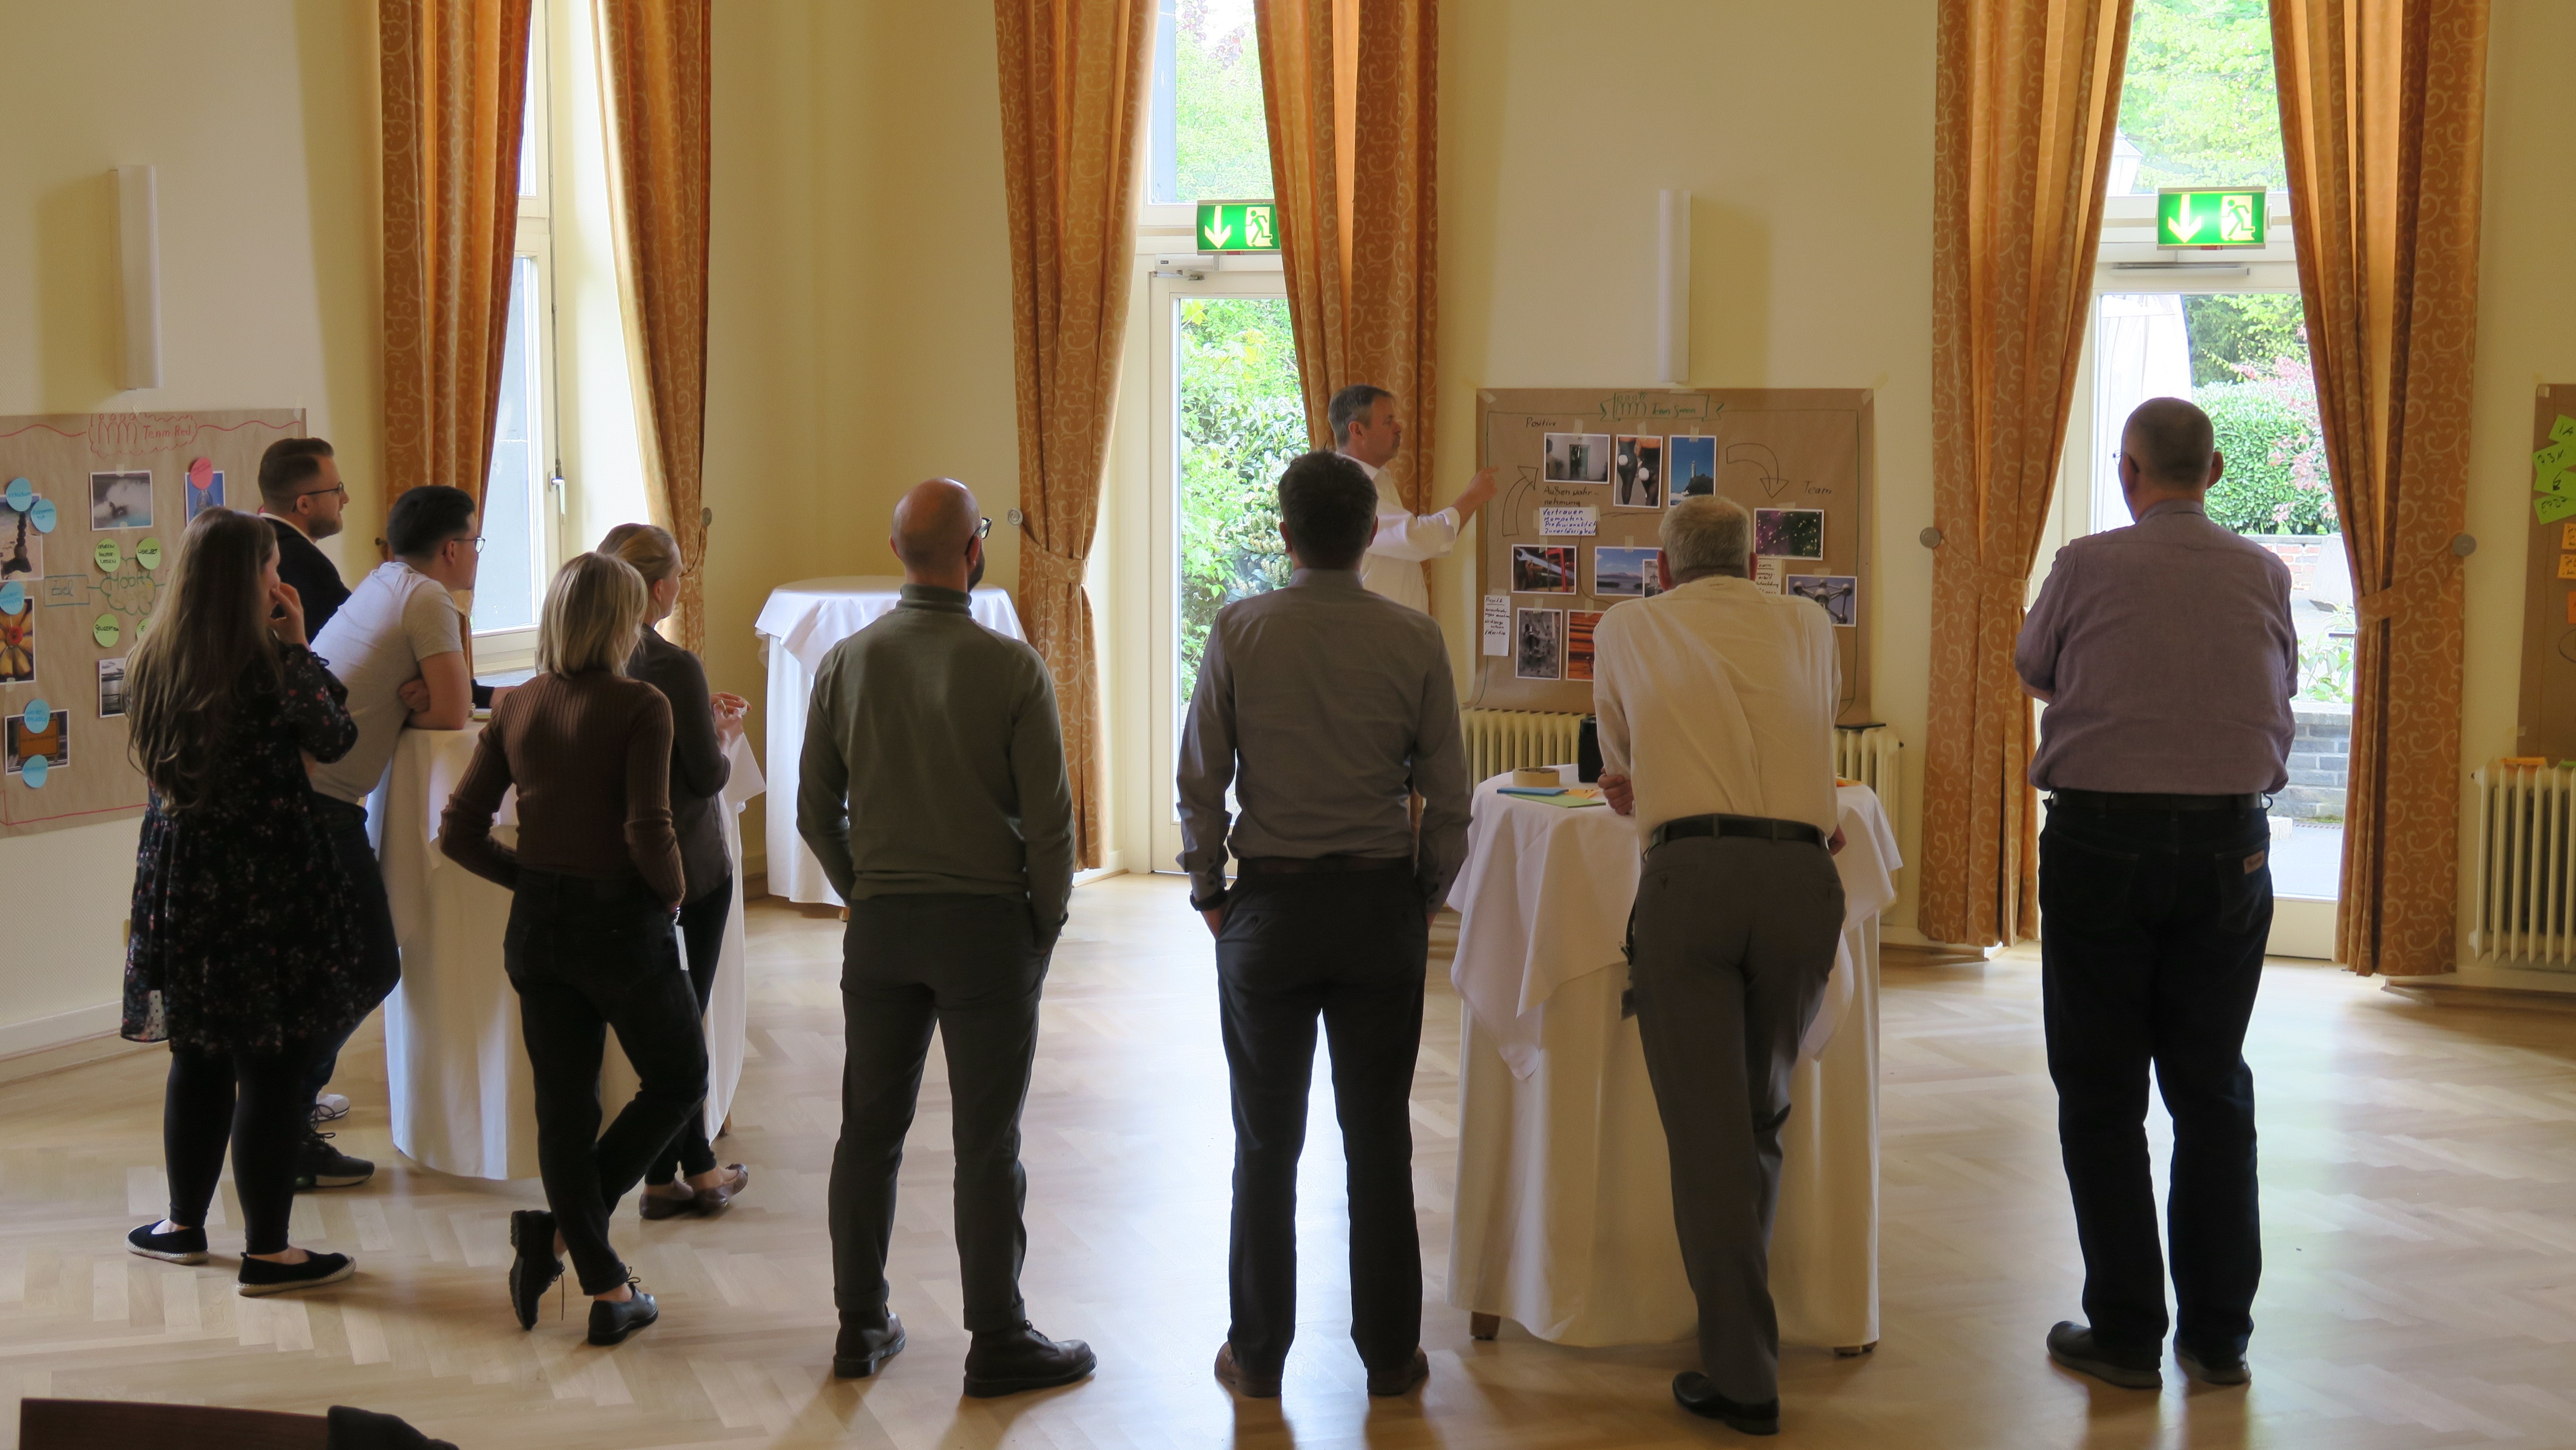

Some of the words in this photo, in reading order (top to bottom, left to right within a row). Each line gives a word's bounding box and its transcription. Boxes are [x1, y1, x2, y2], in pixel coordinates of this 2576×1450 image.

[143, 425, 170, 440] Team
[175, 425, 191, 436] Red
[1805, 481, 1832, 494] Team
[1543, 508, 1583, 516] Vertrauen
